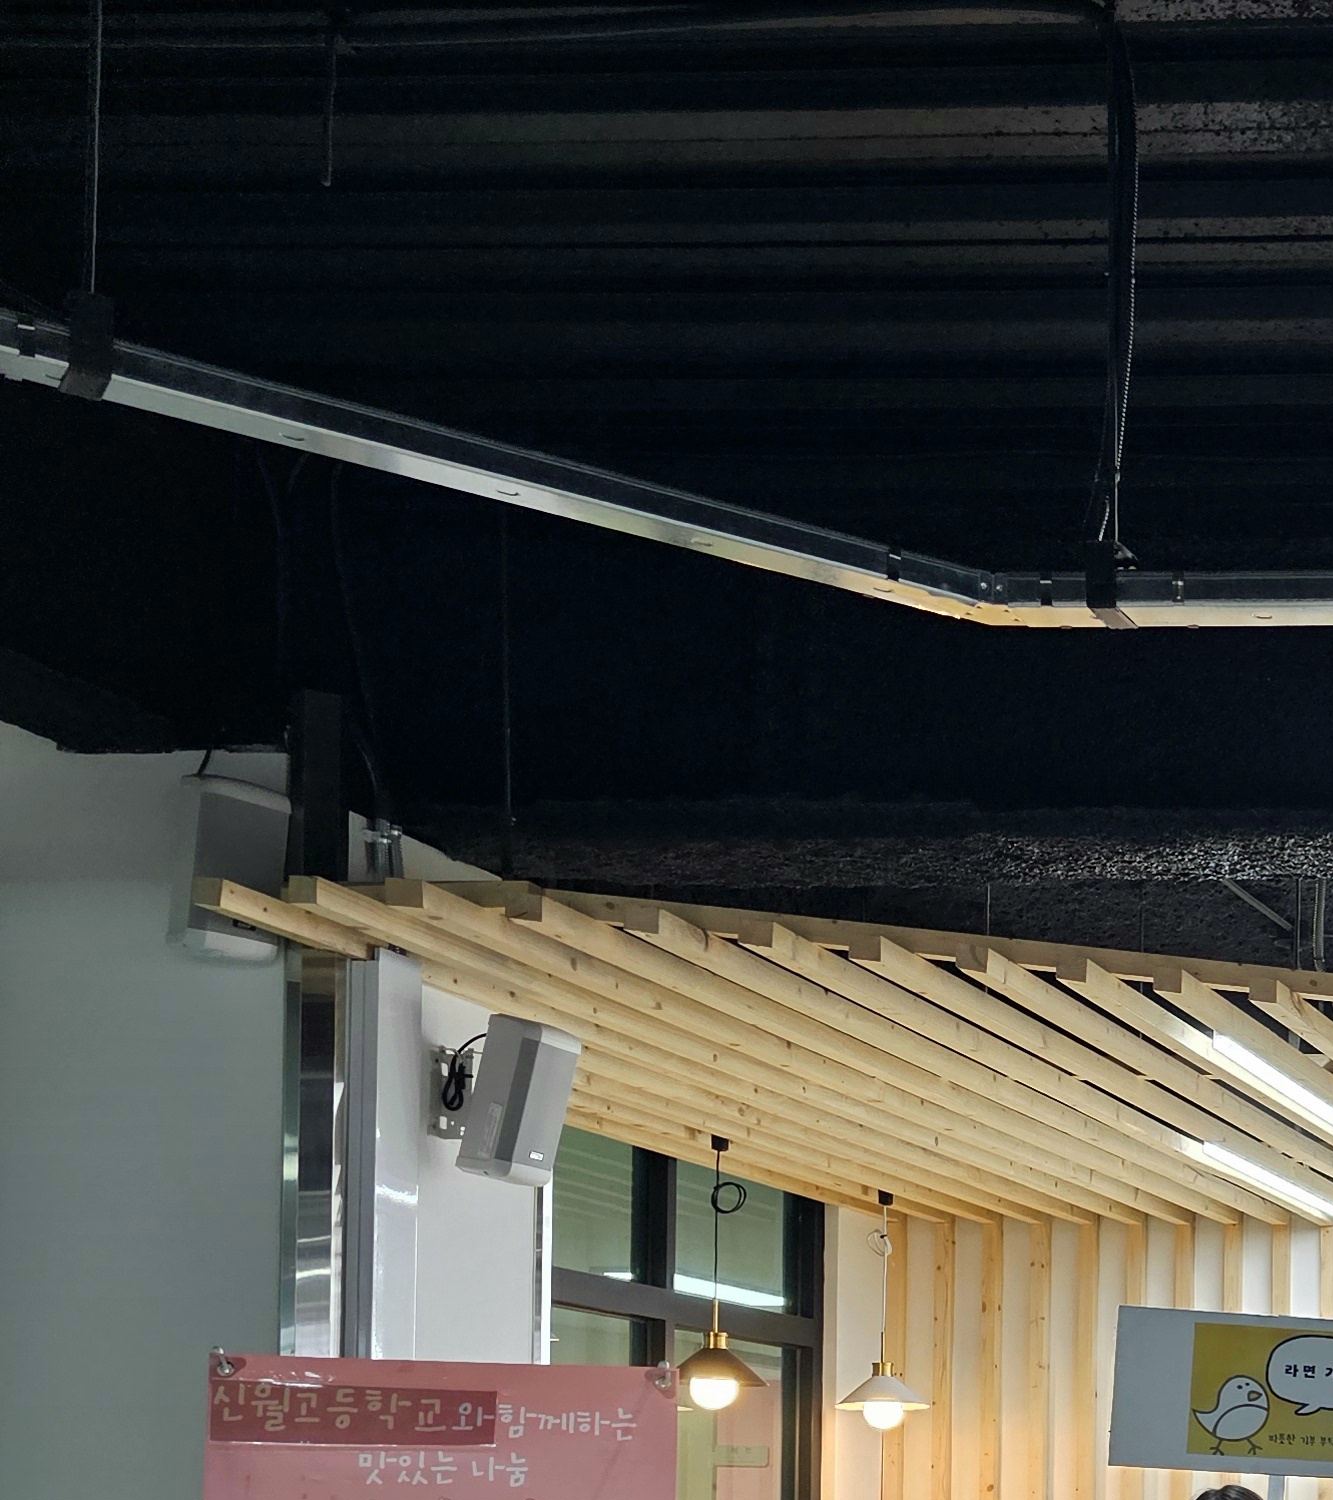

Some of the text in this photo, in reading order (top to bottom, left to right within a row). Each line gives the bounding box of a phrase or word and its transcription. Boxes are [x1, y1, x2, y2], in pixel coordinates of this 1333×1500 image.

[1284, 1364, 1316, 1379] 라면
[1300, 1435, 1316, 1448] 기부
[357, 1450, 530, 1487] 맛있는 나눔
